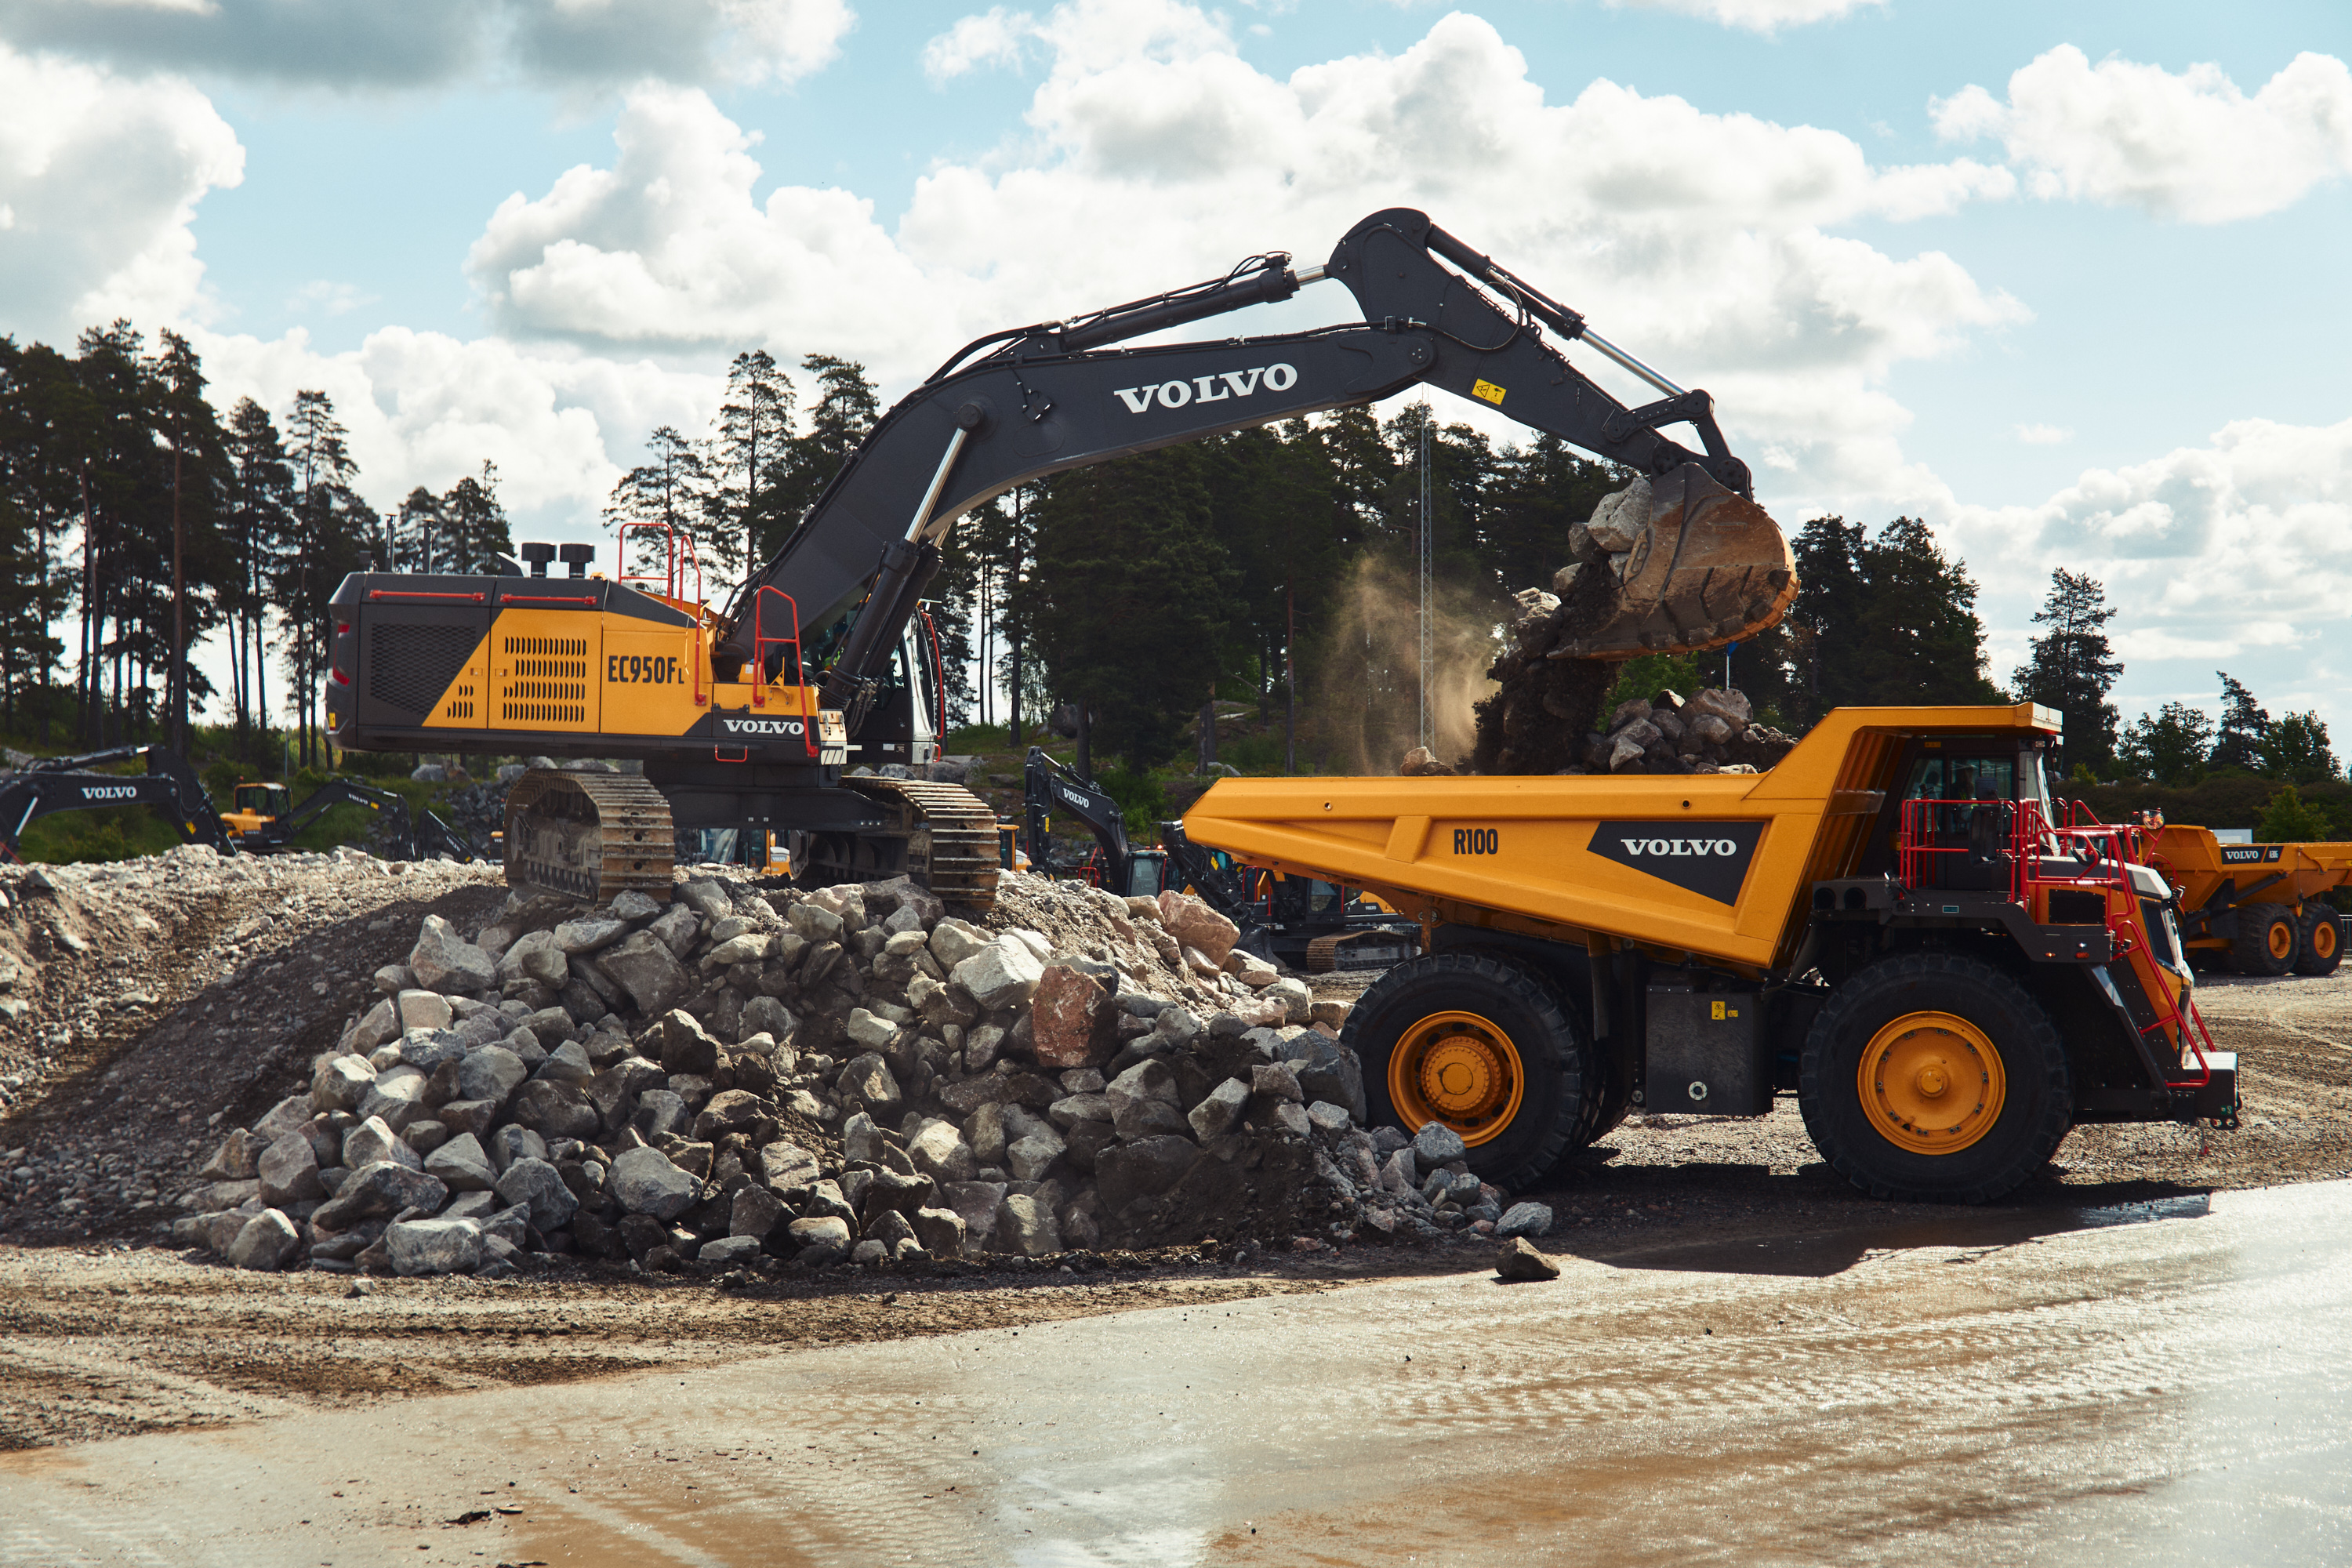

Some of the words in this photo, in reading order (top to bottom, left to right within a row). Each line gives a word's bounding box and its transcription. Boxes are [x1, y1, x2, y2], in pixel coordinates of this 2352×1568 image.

[1113, 362, 1298, 414] VOLVO
[723, 719, 804, 735] VOLVO
[81, 786, 137, 800] VOLVO
[1062, 787, 1089, 808] VOLVO
[1454, 829, 1498, 855] R100
[1621, 839, 1737, 856] VOLVO
[2225, 850, 2259, 860] VOLVO
